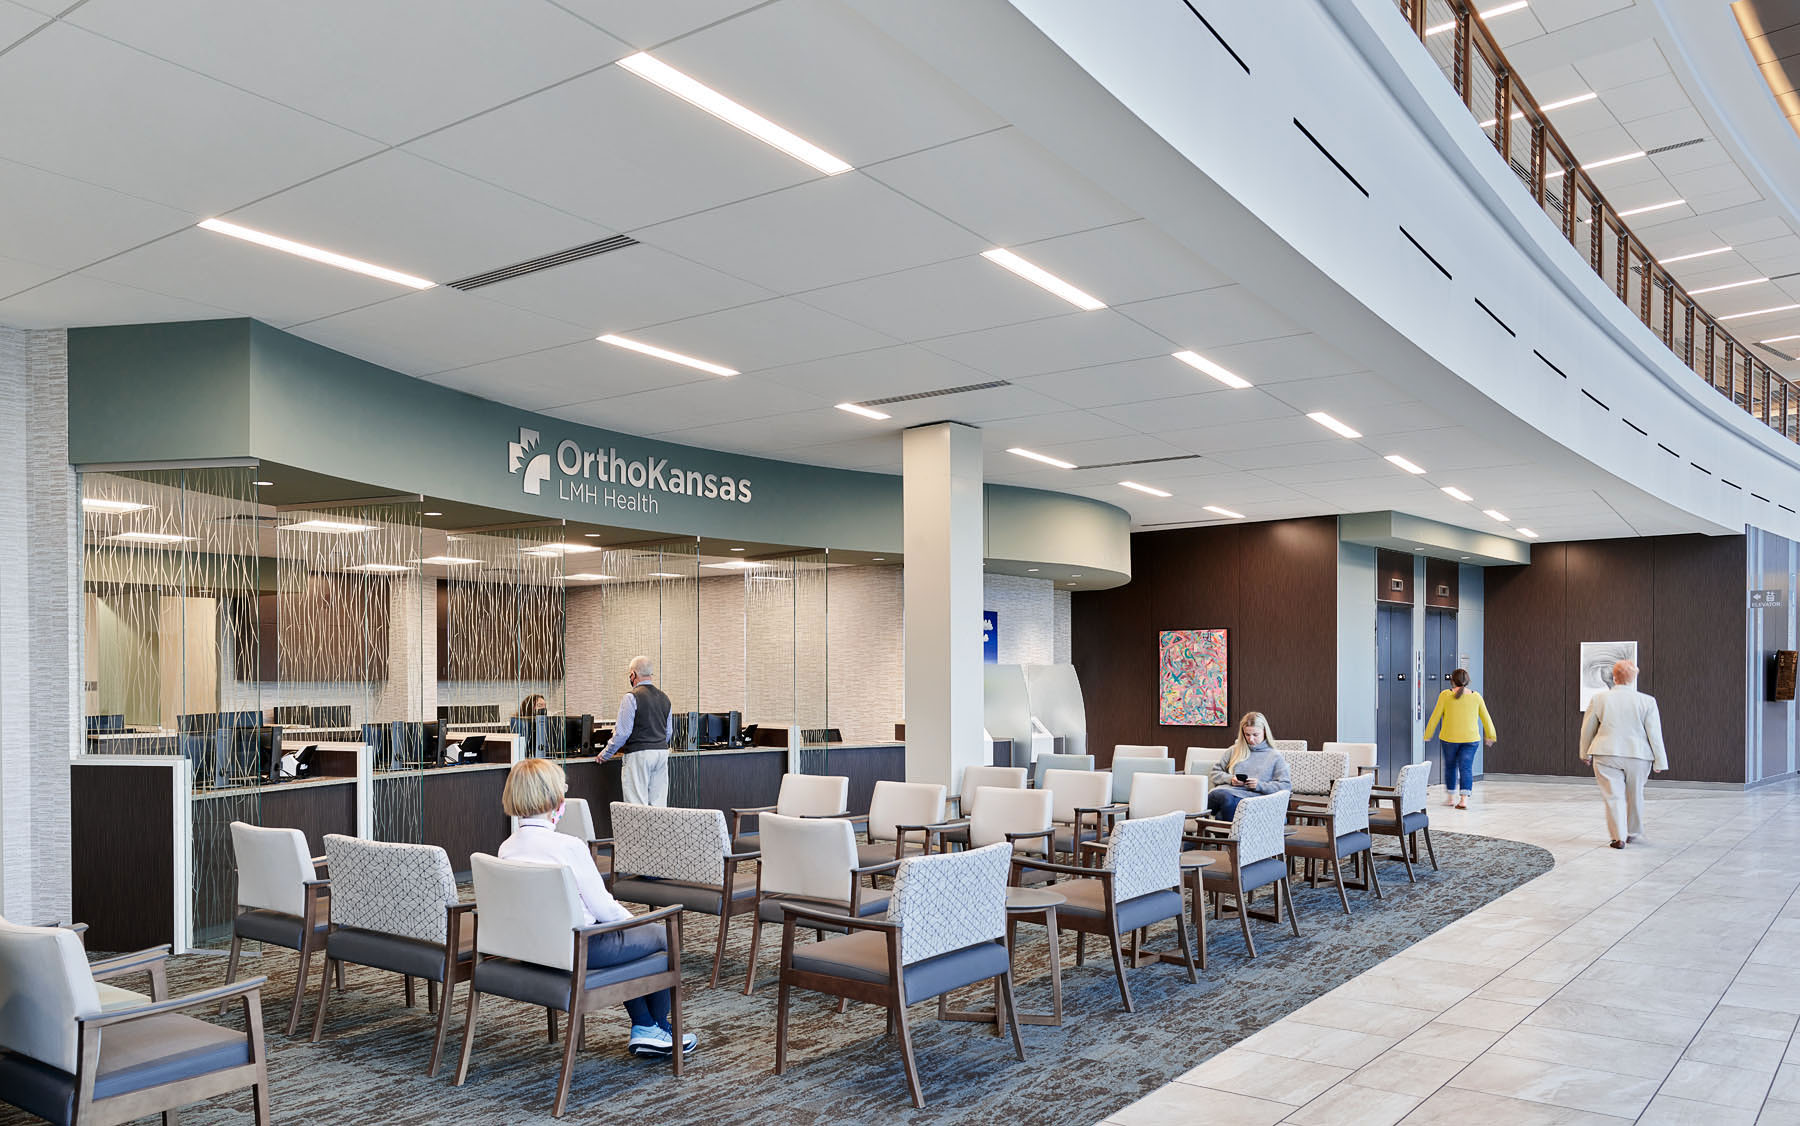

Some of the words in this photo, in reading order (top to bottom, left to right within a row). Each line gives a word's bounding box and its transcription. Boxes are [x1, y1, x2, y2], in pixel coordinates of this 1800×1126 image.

[557, 439, 752, 503] OrthoKansas
[559, 479, 597, 504] LMH
[604, 488, 659, 514] Health
